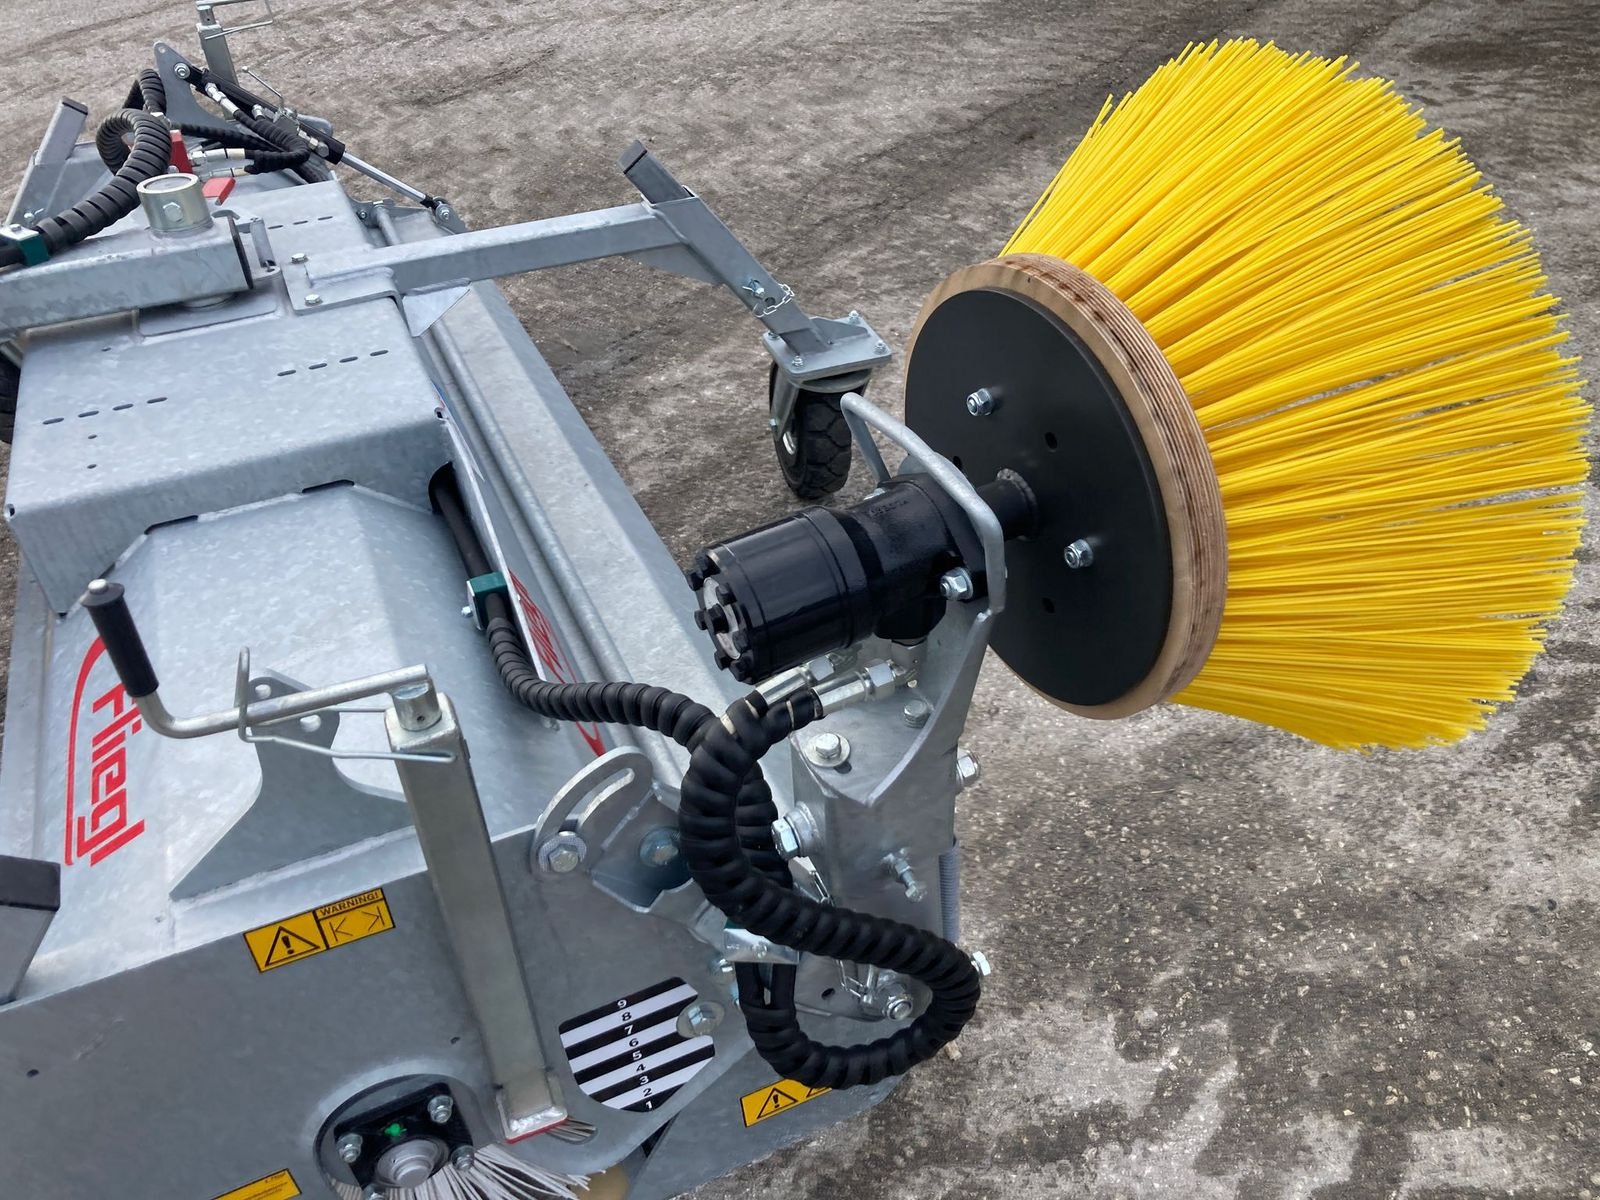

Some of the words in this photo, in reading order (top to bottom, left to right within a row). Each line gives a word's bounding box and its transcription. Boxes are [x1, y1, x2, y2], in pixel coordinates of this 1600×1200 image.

[320, 891, 379, 916] WARNING!
[617, 999, 627, 1009] 9
[622, 1012, 632, 1021] 8
[624, 1025, 634, 1035] 7
[629, 1038, 639, 1047] 6
[632, 1050, 643, 1061] 5
[636, 1063, 646, 1072] 4
[639, 1075, 649, 1085] 3
[643, 1088, 653, 1097] 2
[645, 1101, 653, 1109] 1
